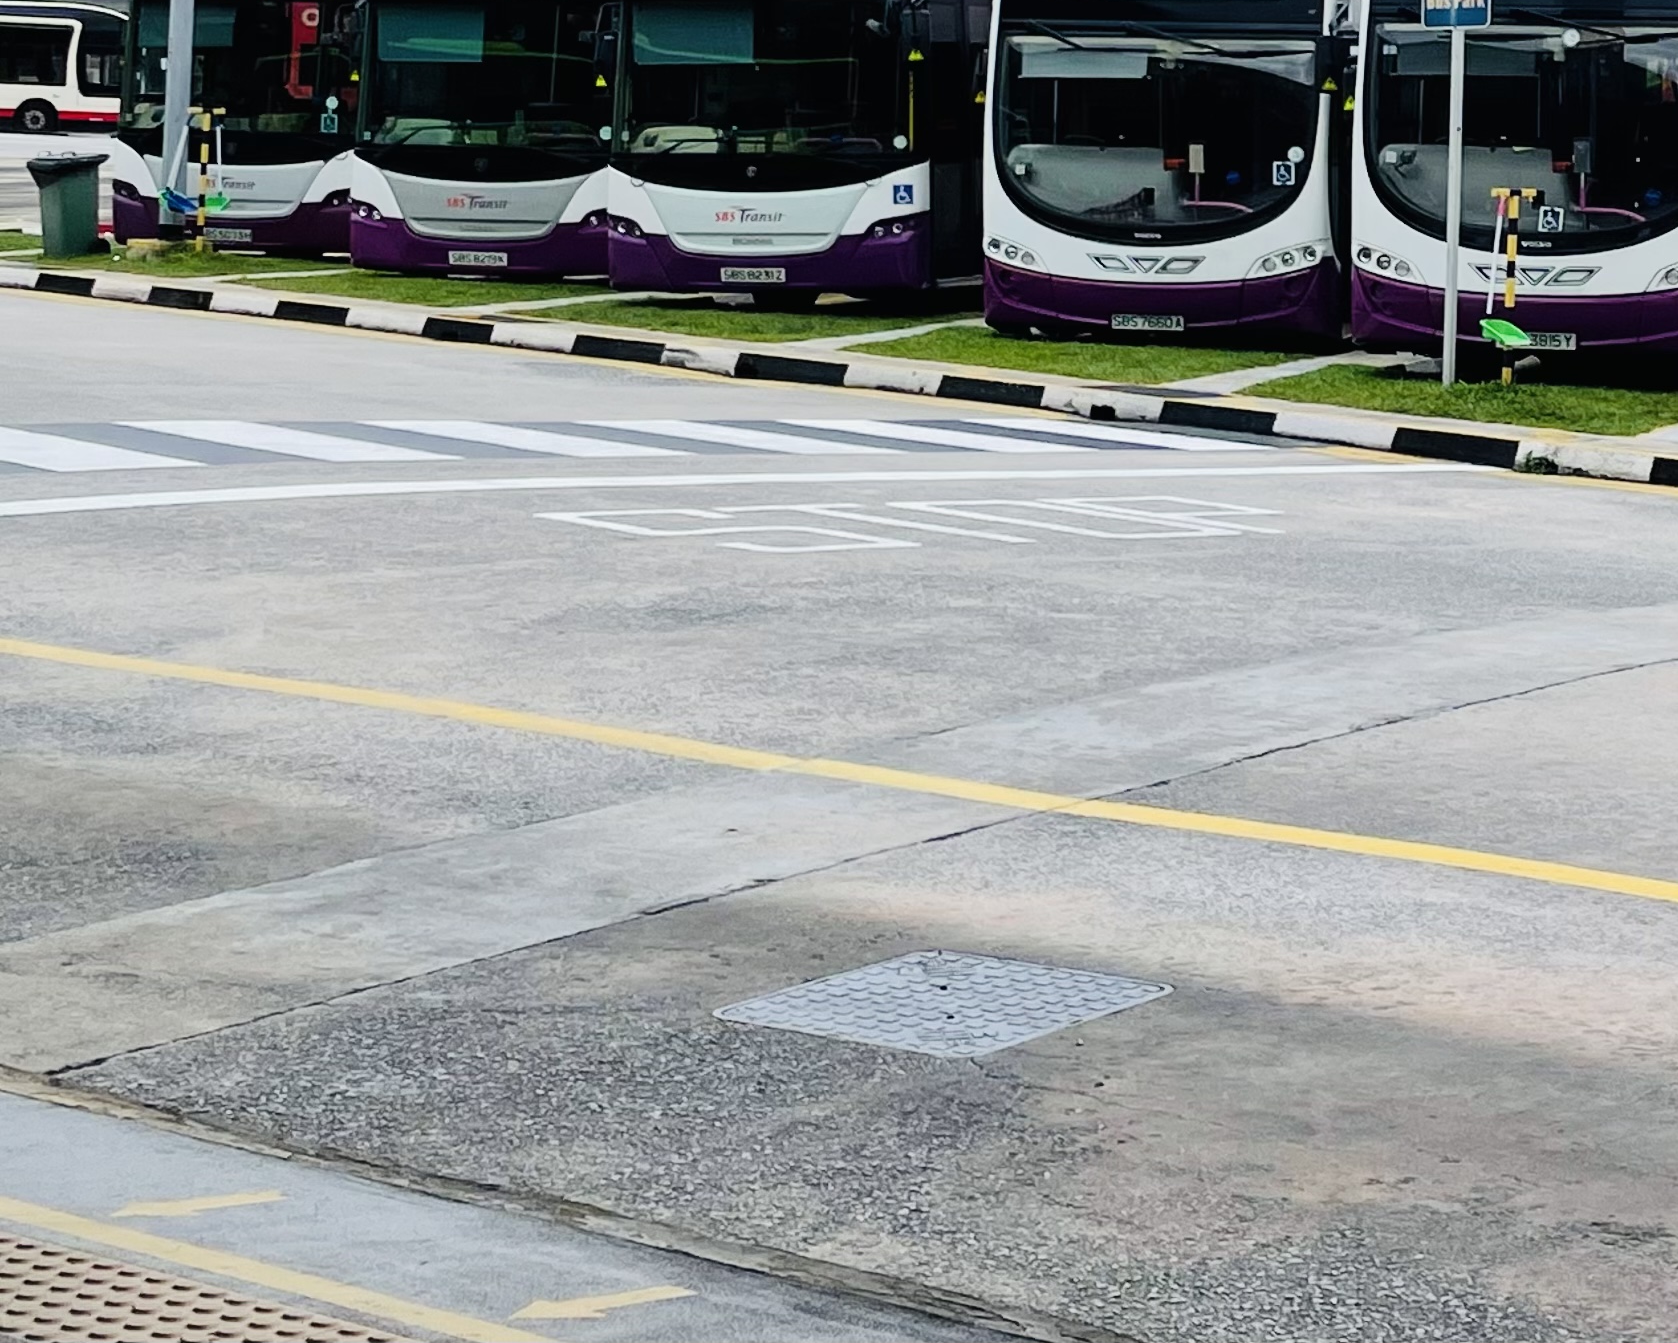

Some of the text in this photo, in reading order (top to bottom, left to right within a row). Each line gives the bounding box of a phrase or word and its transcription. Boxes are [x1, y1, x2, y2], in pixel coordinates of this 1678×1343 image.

[715, 208, 784, 223] SBS Transit
[533, 496, 1286, 553] STOP
